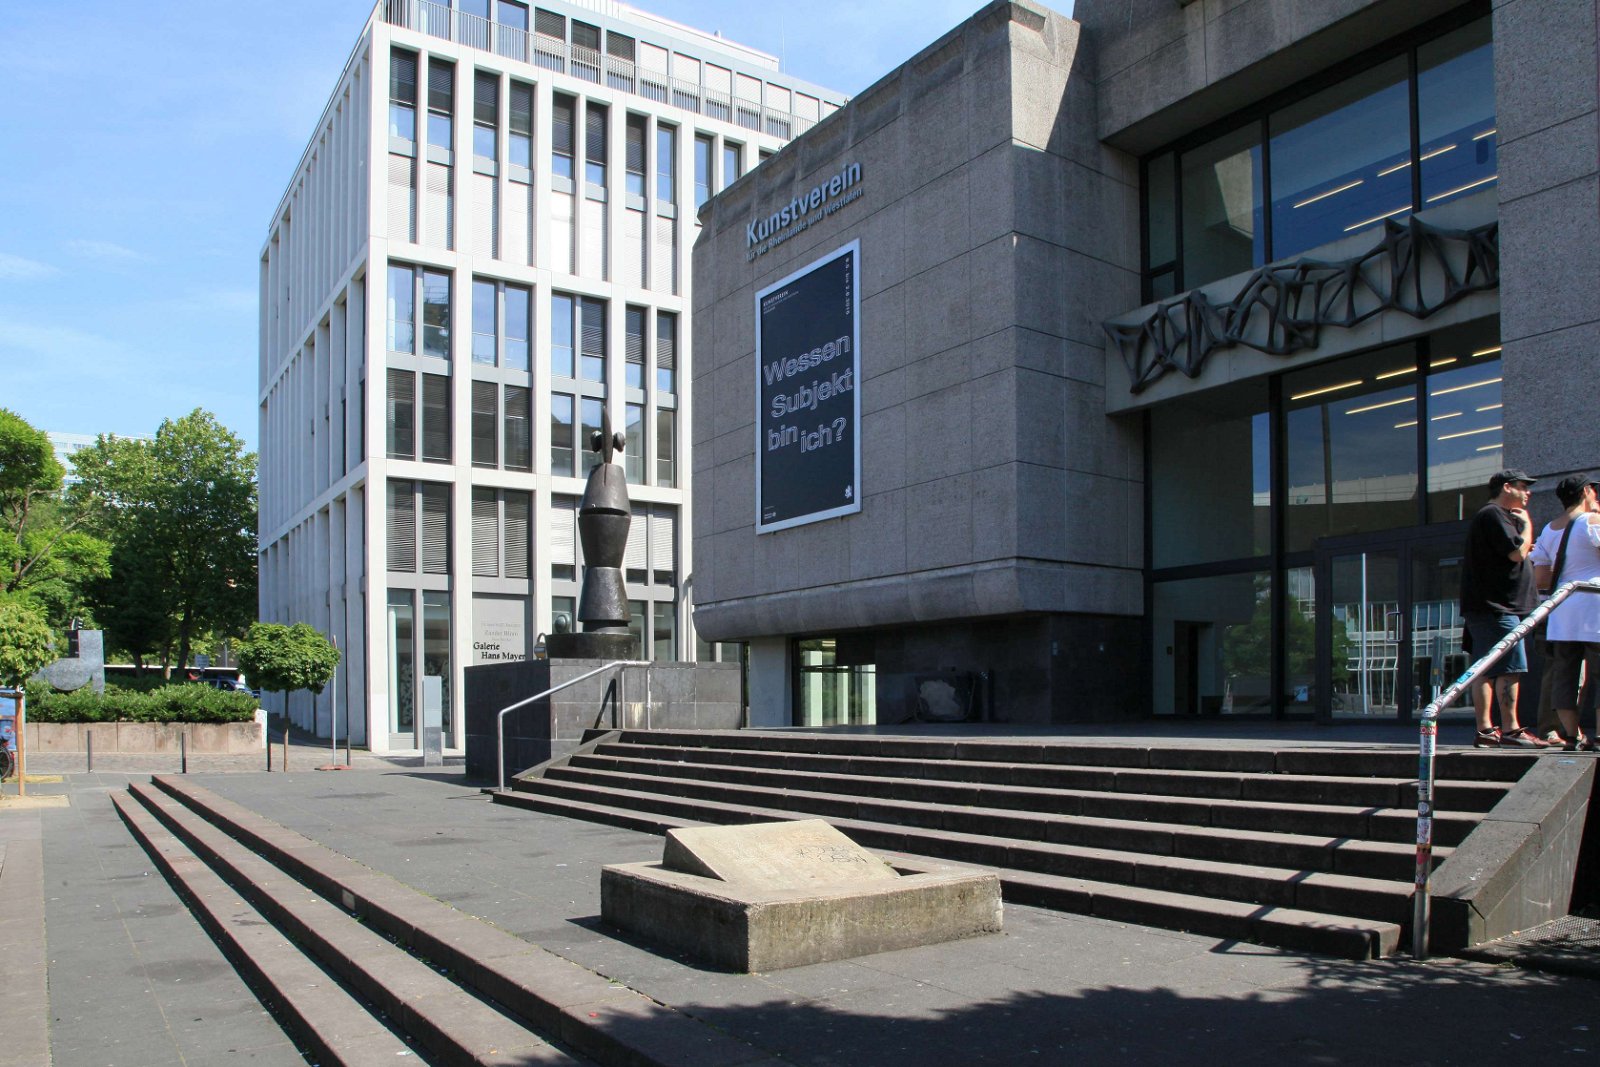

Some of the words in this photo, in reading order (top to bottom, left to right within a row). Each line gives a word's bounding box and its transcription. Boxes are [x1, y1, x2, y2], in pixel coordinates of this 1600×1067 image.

[746, 162, 861, 248] Kunstverein
[763, 335, 850, 386] Wessen
[771, 367, 853, 418] Subjekt
[768, 424, 798, 452] bin
[473, 641, 500, 650] Galerie
[481, 651, 500, 660] Hans
[502, 651, 526, 662] Mayer
